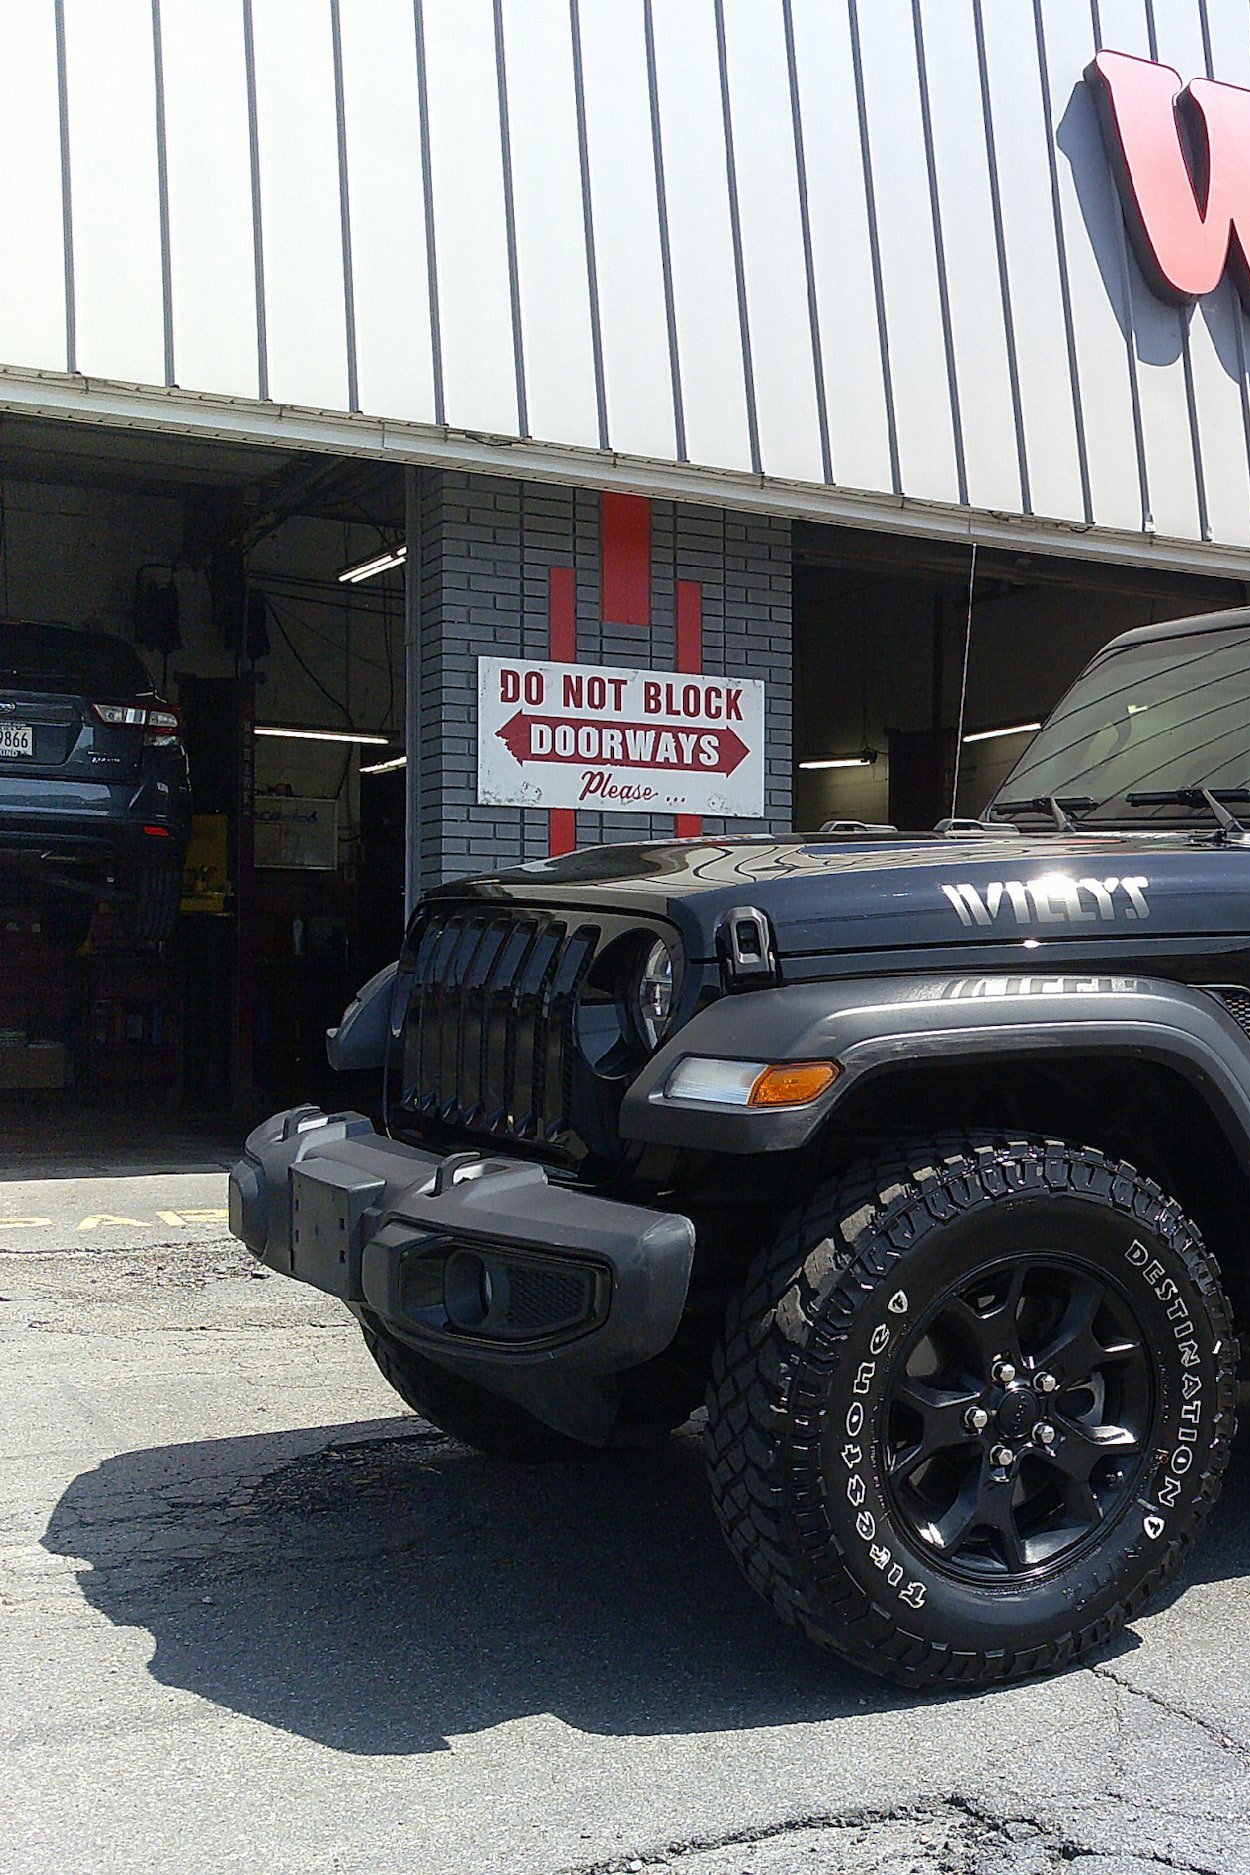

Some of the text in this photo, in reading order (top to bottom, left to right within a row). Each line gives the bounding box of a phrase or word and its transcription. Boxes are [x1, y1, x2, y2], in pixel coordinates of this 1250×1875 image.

[500, 669, 744, 721] DO NOT BLOCK
[530, 723, 720, 766] DOORWAYS
[578, 770, 659, 801] Please
[941, 876, 1150, 926] WILLYS
[1124, 1239, 1202, 1507] DESTINATION
[841, 1323, 926, 1608] Firestone
